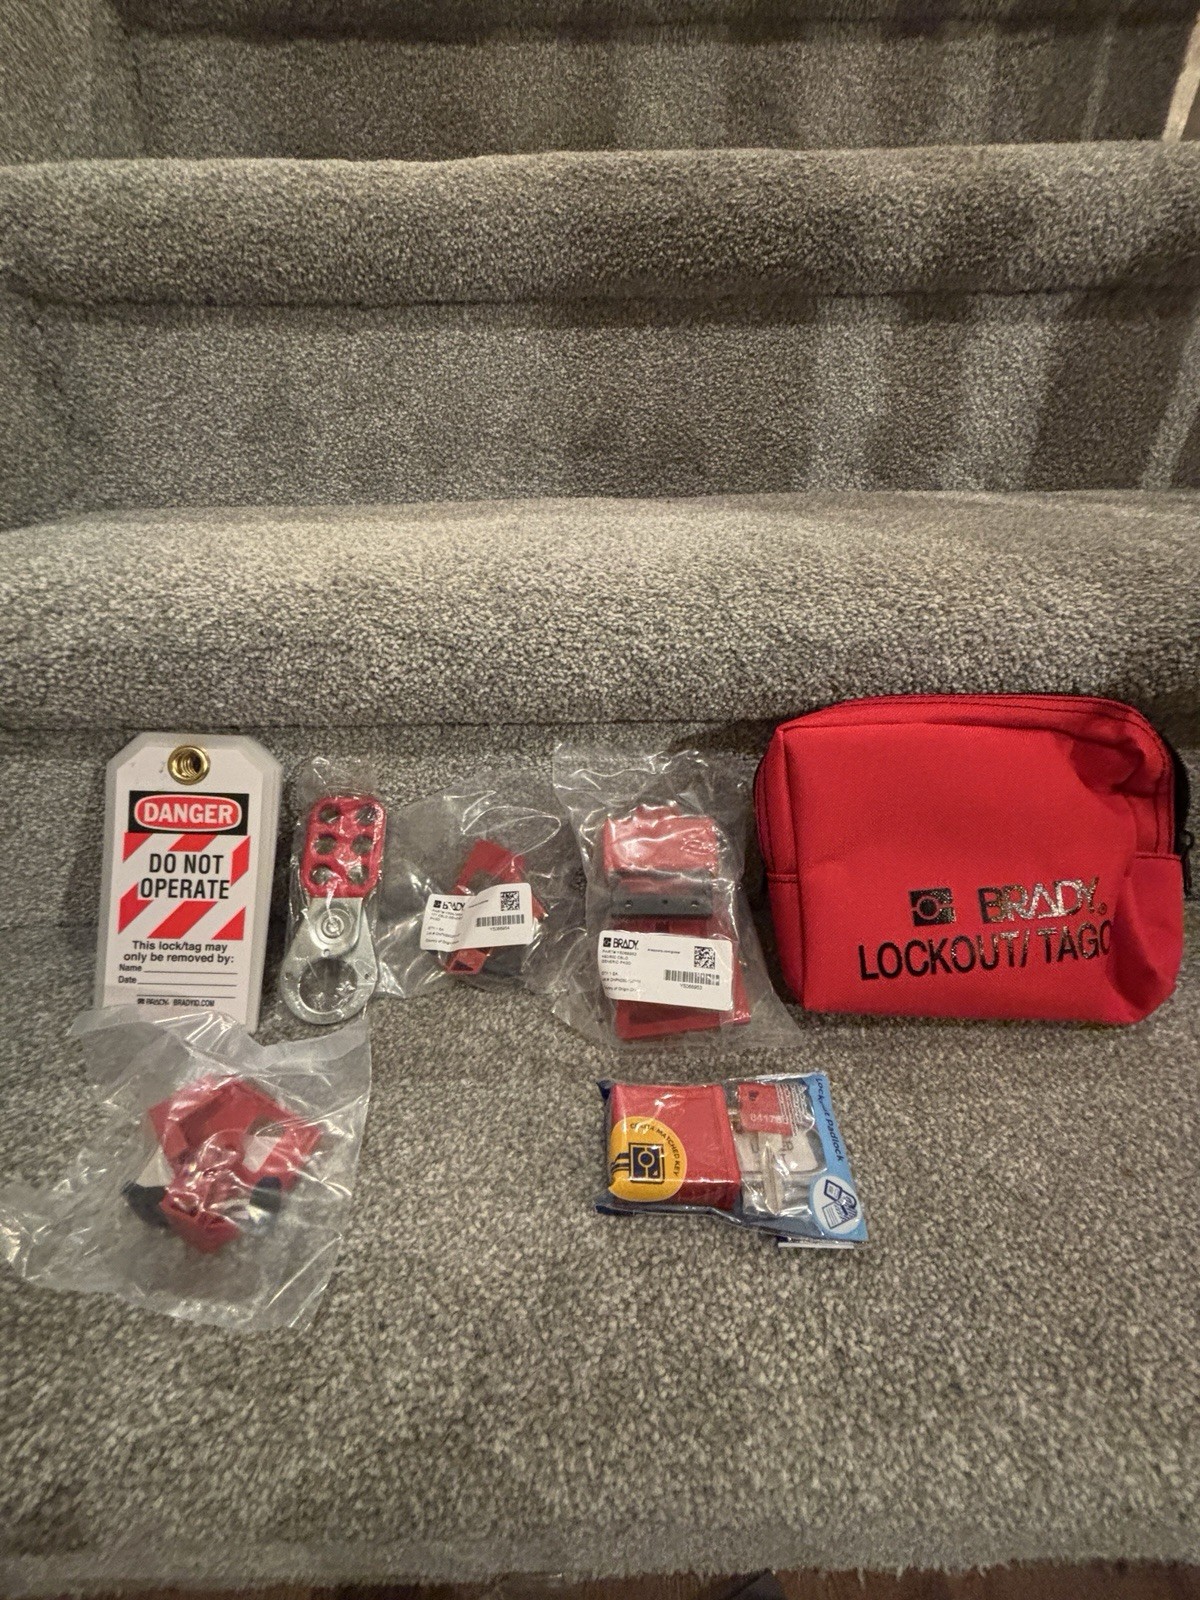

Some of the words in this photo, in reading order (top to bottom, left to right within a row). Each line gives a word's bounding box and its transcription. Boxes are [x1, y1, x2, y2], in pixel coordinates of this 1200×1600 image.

[143, 802, 234, 825] DANGER
[149, 853, 176, 873] DO
[183, 854, 224, 875] NOT
[140, 877, 230, 899] OPERATE
[132, 940, 156, 951] This
[159, 942, 202, 953] lock/tag
[205, 944, 228, 954] may
[612, 937, 639, 950] BRADY
[123, 953, 147, 963] only
[150, 953, 164, 961] be
[167, 954, 214, 963] removed
[217, 954, 234, 965] by:
[118, 975, 137, 984] Date
[826, 1118, 844, 1162] padlock
[673, 1160, 681, 1177] KEY
